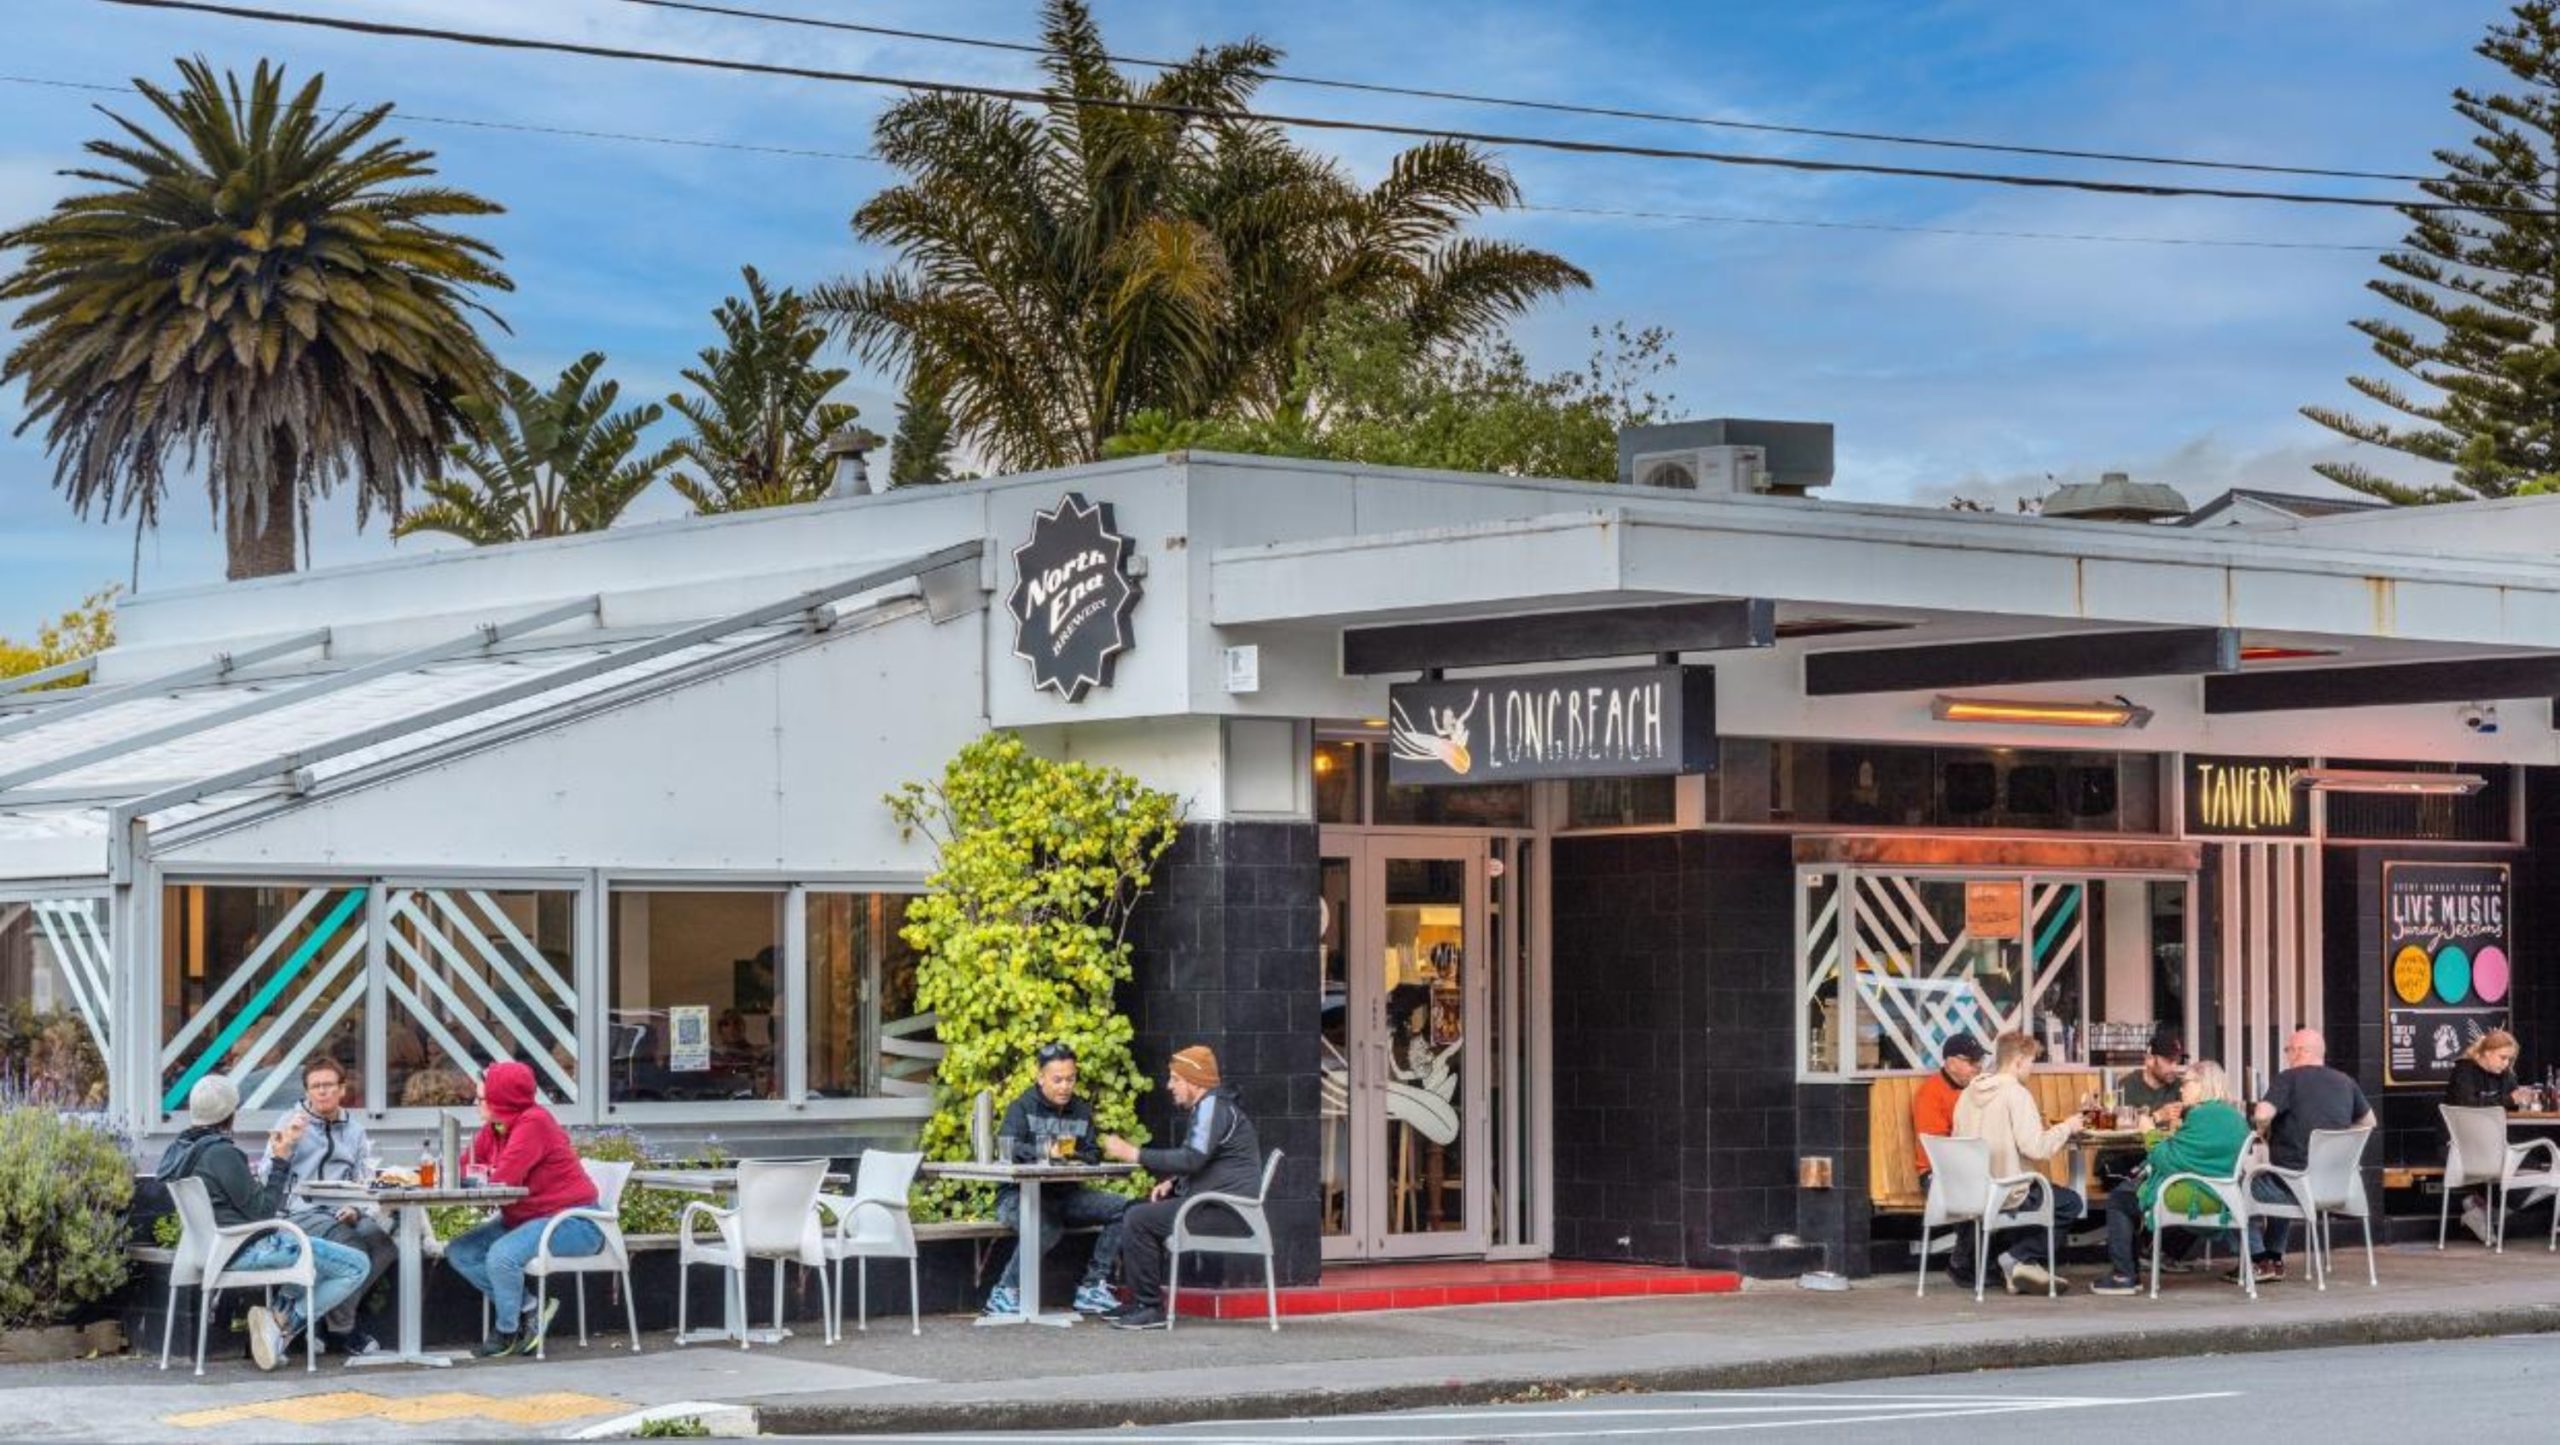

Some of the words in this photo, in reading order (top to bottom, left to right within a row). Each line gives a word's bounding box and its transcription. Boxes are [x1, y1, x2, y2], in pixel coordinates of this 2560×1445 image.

[1026, 550, 1107, 620] North
[1050, 574, 1104, 636] End
[1053, 597, 1108, 657] BREWERY
[1487, 682, 1664, 767] LONGBEACH
[2197, 764, 2292, 829] TAVERN
[2391, 916, 2444, 953] Sunday
[2442, 918, 2503, 940] Sessions
[2392, 894, 2433, 923] LIVE
[2441, 894, 2502, 924] MUSIC
